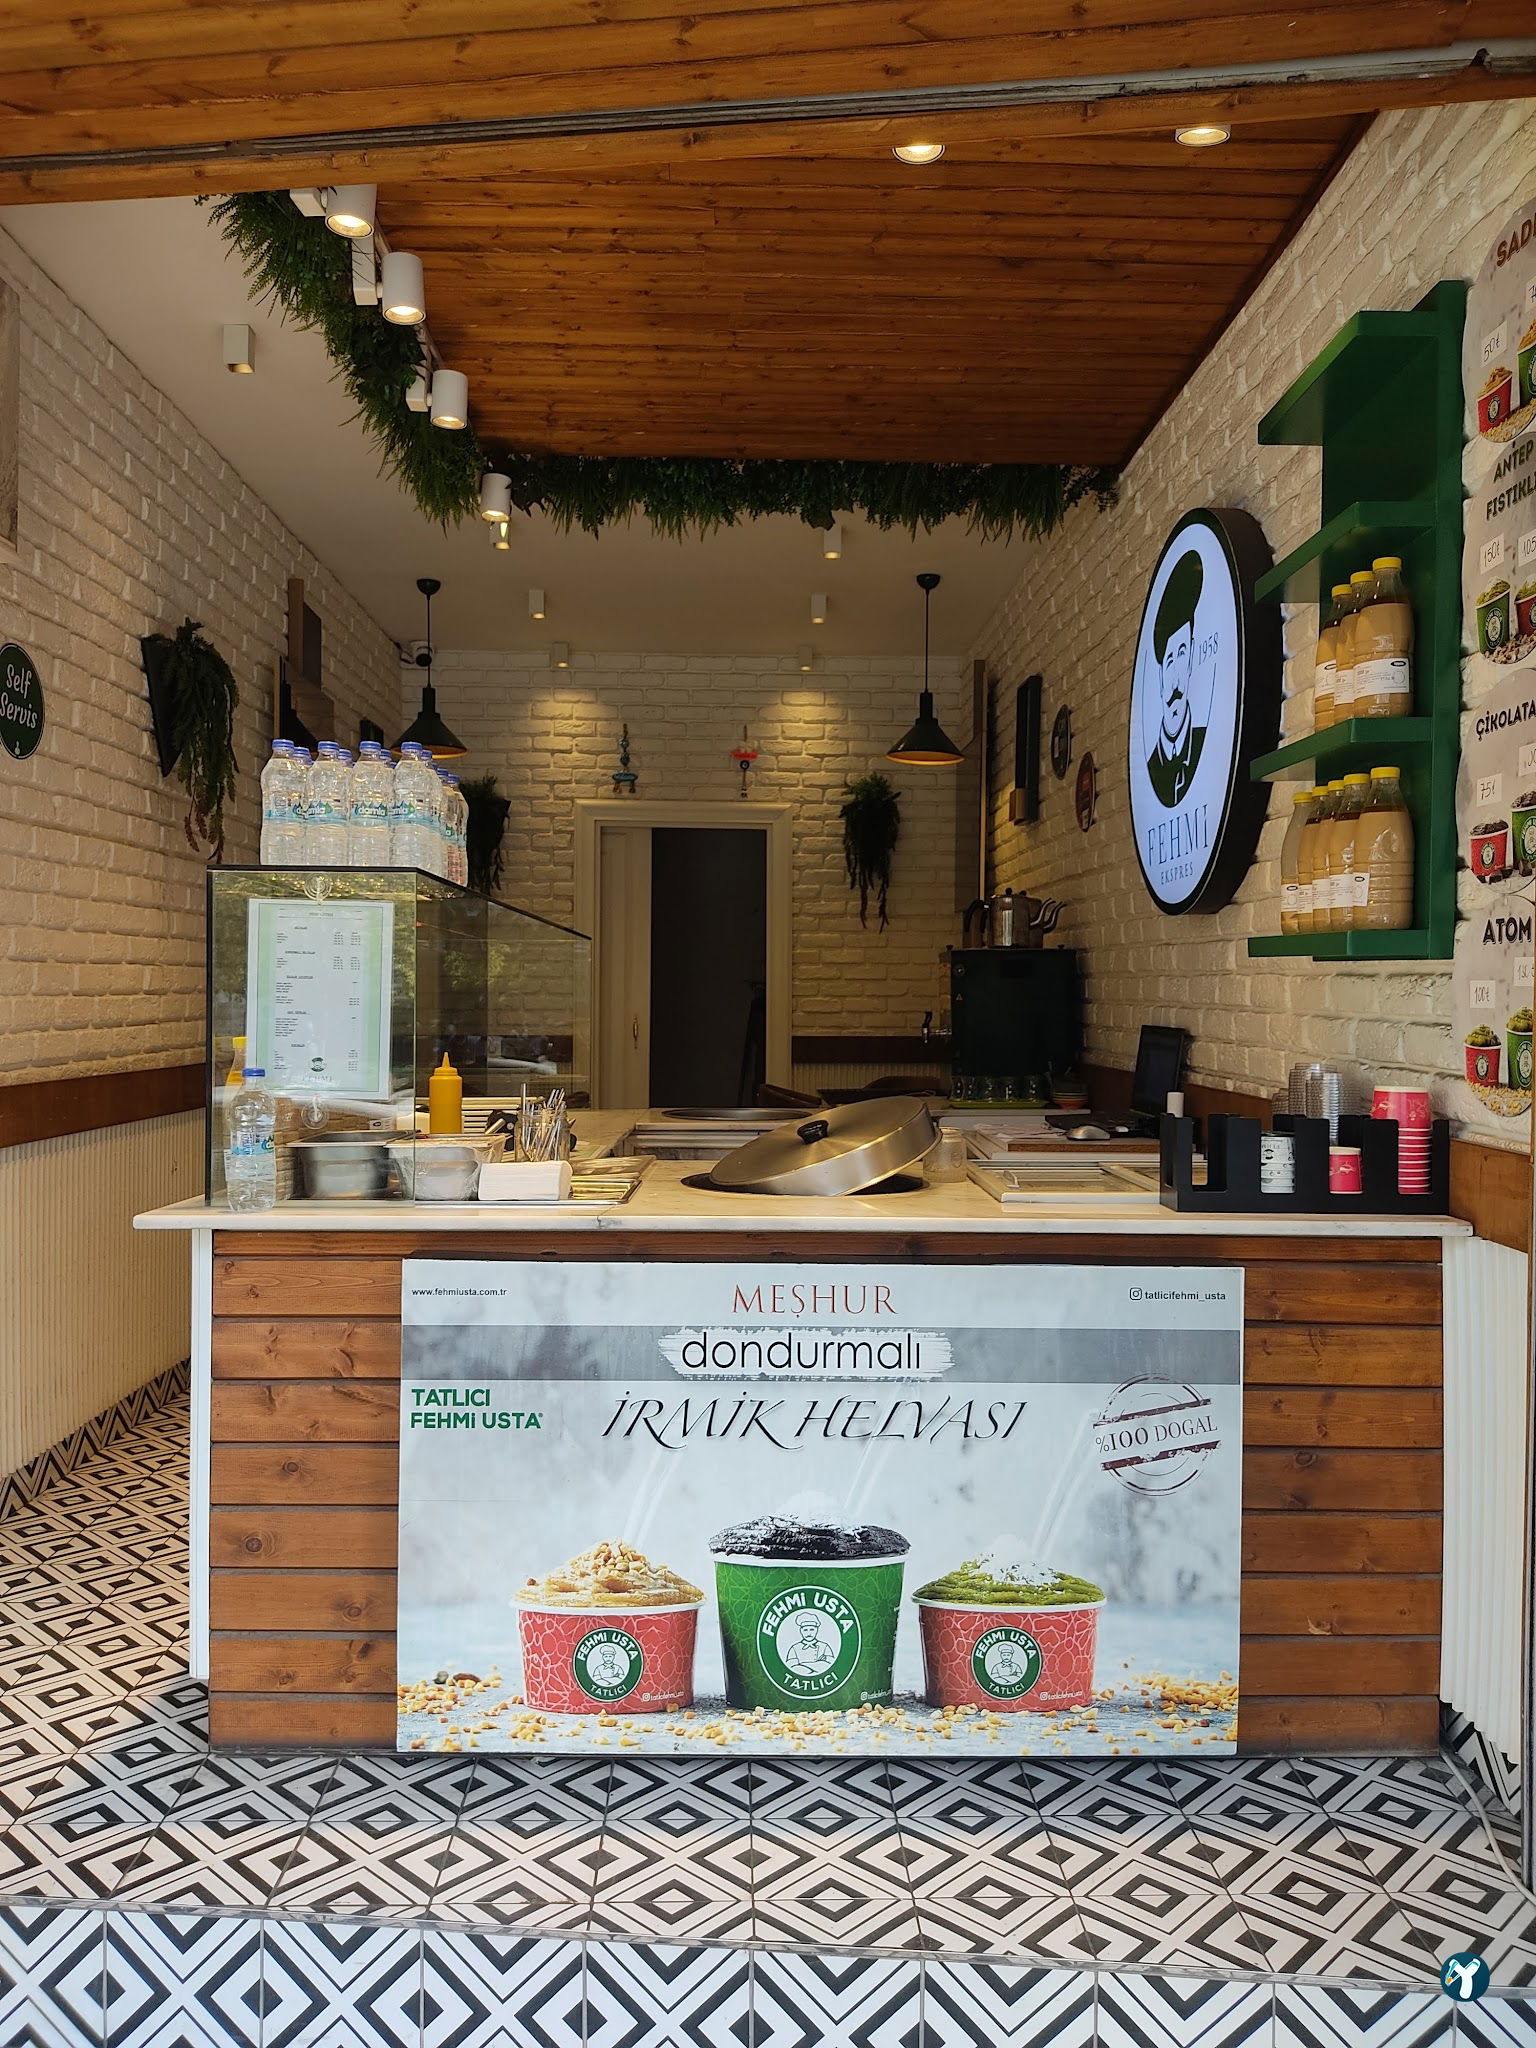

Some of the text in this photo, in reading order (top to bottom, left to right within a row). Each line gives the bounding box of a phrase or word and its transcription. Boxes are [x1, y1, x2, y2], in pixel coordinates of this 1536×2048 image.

[1493, 439, 1534, 483] ANTEP
[1198, 631, 1219, 666] 1958
[6, 663, 32, 699] Self
[0, 691, 38, 729] Servis
[1475, 699, 1536, 741] ÇİKOLATA
[357, 805, 386, 817] damla
[1160, 861, 1194, 886] EKSPRES
[1482, 915, 1532, 945] ATOM
[411, 1287, 507, 1296] www.fehmiusta.com.tr
[731, 1284, 899, 1319] MEŞHUR
[1144, 1290, 1226, 1302] tatlicifehmi_usta
[681, 1331, 920, 1369] dondurmalı
[411, 1388, 491, 1407] TATLICI
[601, 1390, 1028, 1450] İRMİK HELVASI
[1095, 1415, 1218, 1454] %100 DOGAL
[813, 1592, 854, 1634] USTA
[611, 1632, 639, 1660] USTA
[1010, 1631, 1037, 1660] USTA
[590, 1684, 628, 1697] TATLICI
[783, 1671, 838, 1691] TATLICI
[988, 1682, 1025, 1695] TATLICI
